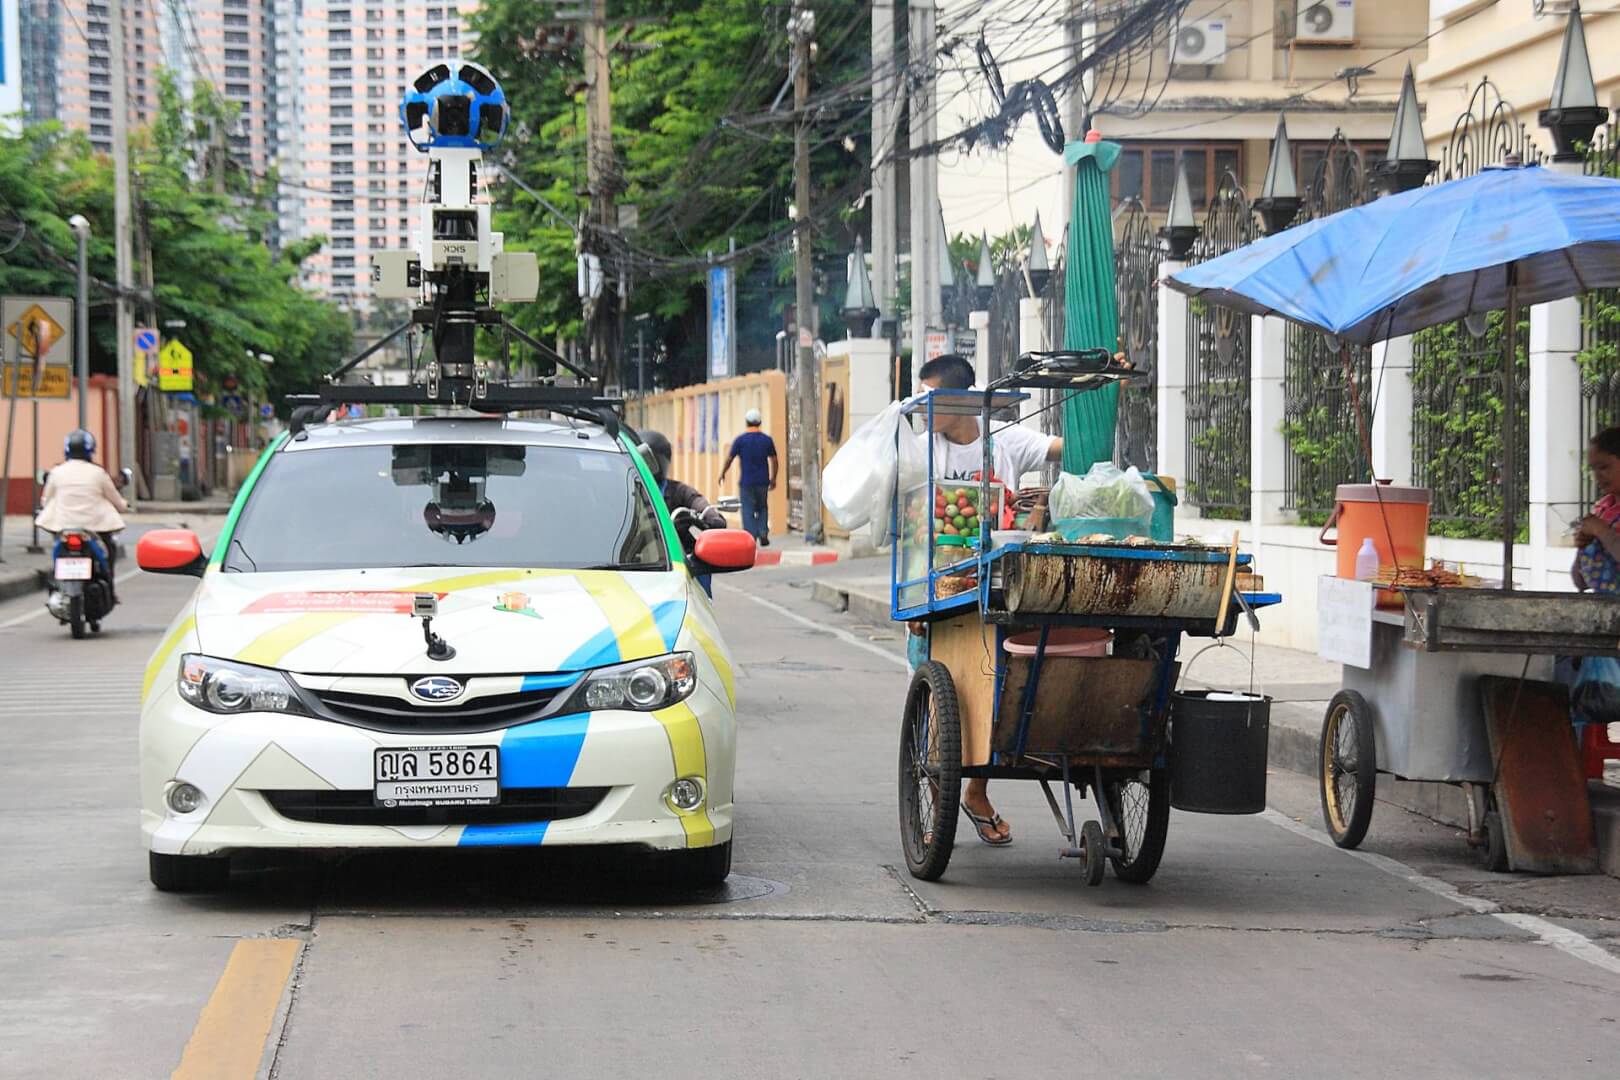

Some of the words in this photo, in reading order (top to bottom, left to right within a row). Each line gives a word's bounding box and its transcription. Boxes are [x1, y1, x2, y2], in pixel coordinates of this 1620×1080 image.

[443, 244, 466, 254] SICK
[380, 753, 418, 780] ญล
[429, 751, 493, 776] 5864
[395, 784, 480, 798] กรุงเทพมหานคร
